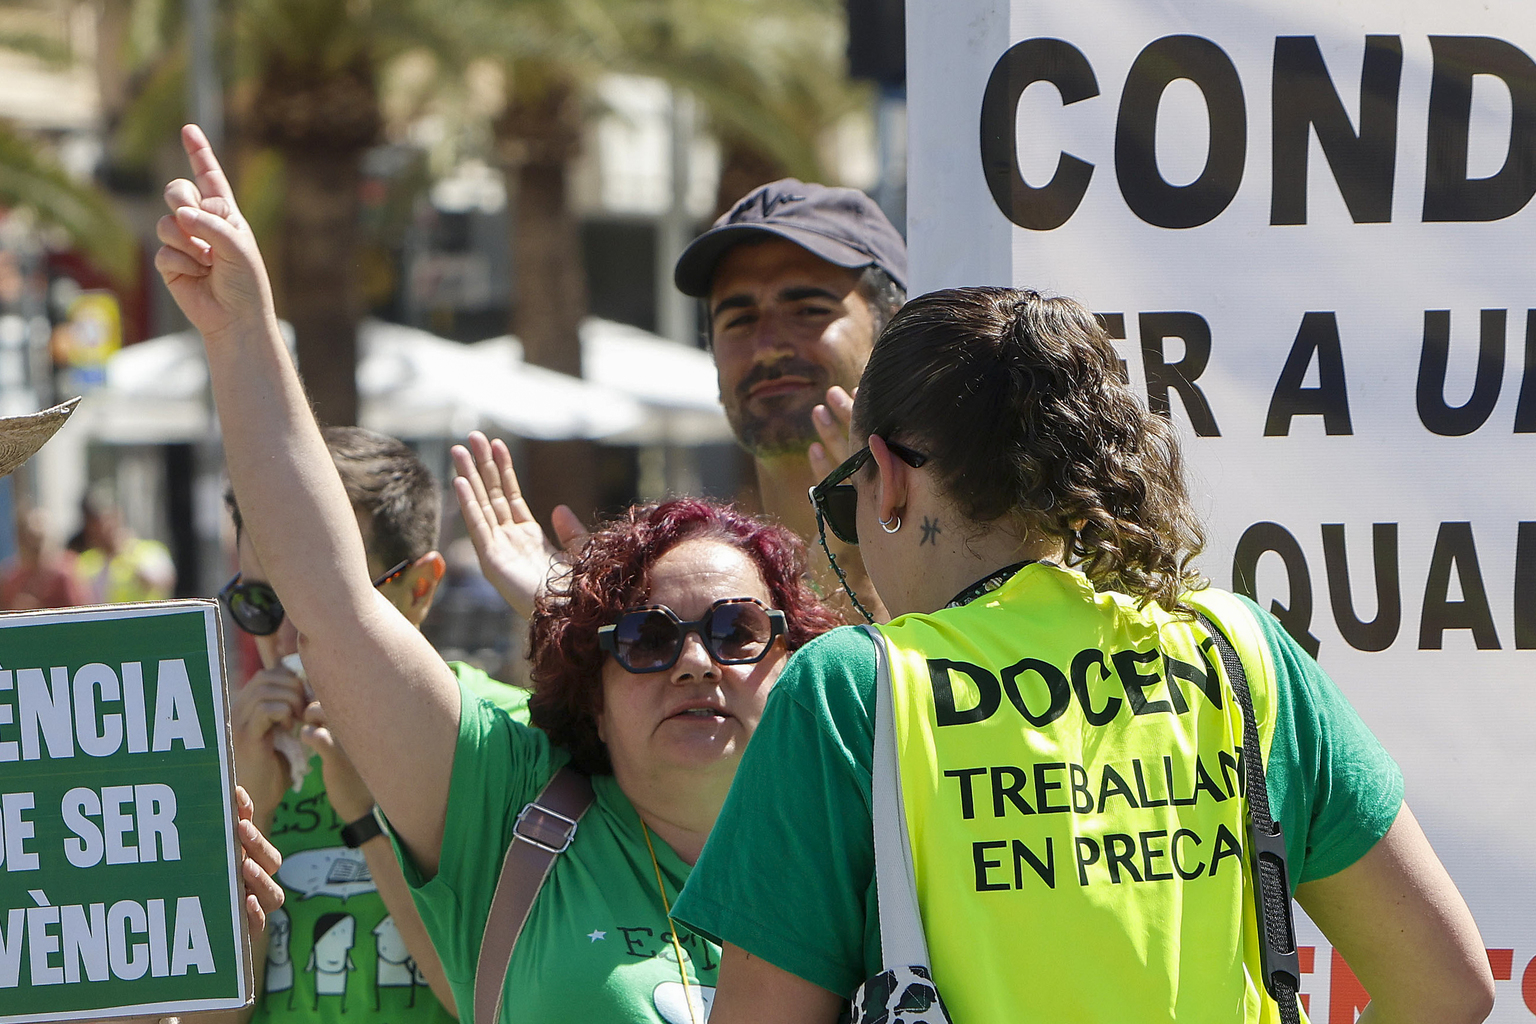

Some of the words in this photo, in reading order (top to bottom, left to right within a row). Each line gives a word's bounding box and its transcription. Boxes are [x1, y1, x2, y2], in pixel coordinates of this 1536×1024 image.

[979, 33, 1536, 231] COND
[1263, 311, 1354, 437] A
[1415, 308, 1536, 437] U
[1232, 520, 1536, 662] QUA
[926, 636, 1240, 727] DOCEN
[61, 783, 181, 869] SER
[971, 836, 1056, 892] EN
[1074, 823, 1245, 887] PRECA
